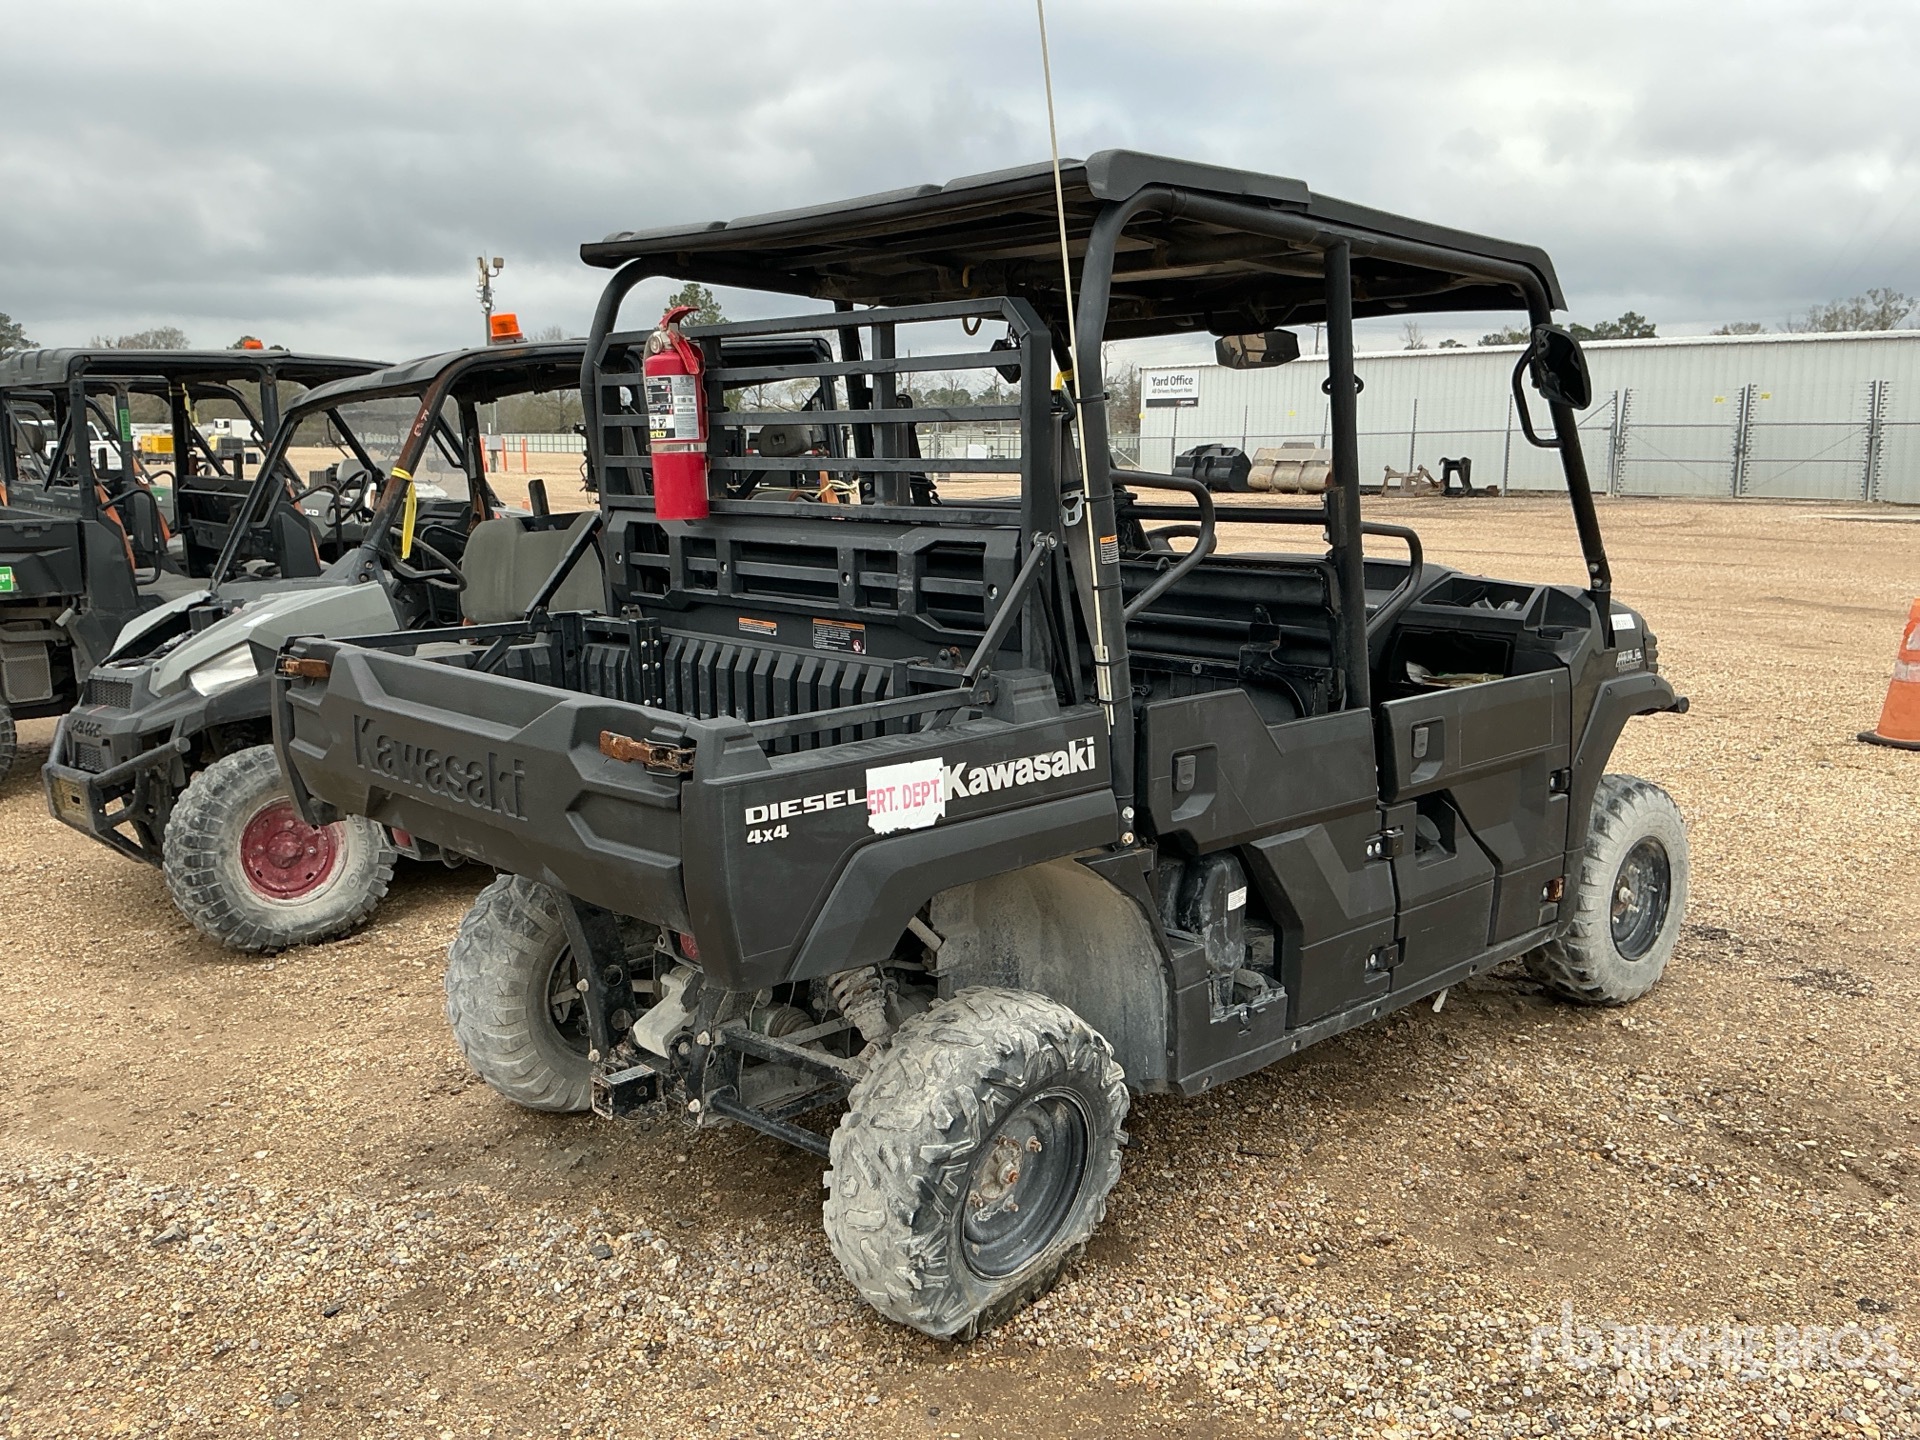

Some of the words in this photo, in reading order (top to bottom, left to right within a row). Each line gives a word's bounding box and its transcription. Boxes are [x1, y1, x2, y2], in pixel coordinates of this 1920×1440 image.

[1151, 376, 1168, 386] Yard
[1170, 375, 1193, 385] Office
[354, 714, 528, 822] Kawasaki
[943, 735, 1096, 802] Kawasaki
[744, 788, 868, 826] DIESEL
[902, 778, 944, 811] DEPT.
[746, 823, 790, 845] 4x4
